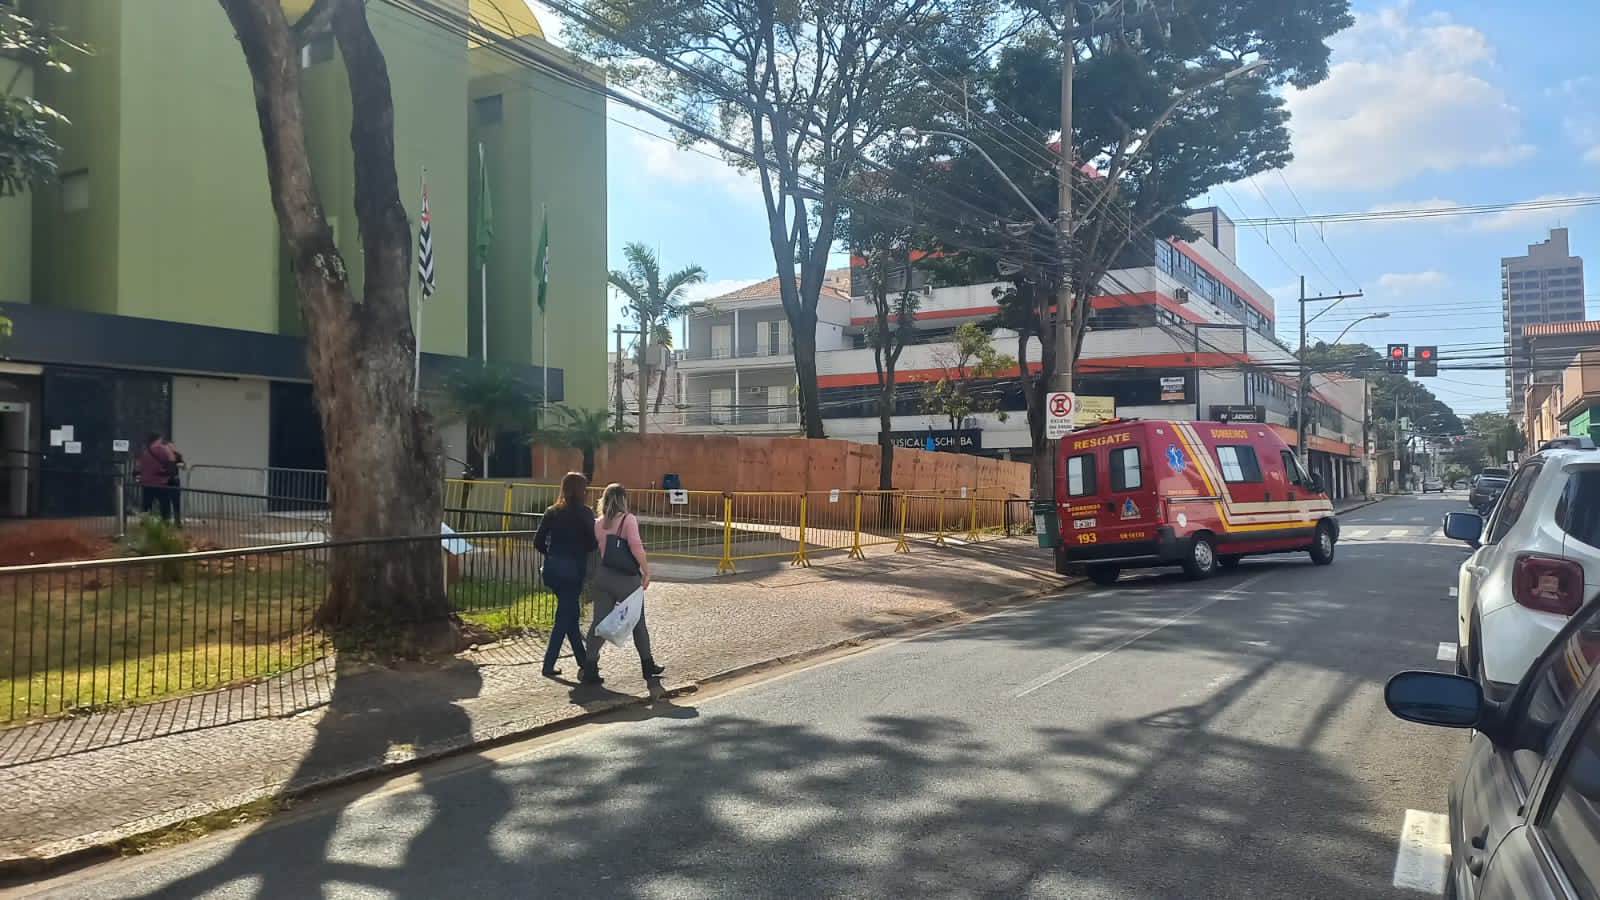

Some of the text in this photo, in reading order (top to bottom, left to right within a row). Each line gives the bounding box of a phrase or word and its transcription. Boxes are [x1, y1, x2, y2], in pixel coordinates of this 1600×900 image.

[891, 437, 926, 448] USICAL
[1074, 432, 1131, 450] RESGATE
[1077, 532, 1097, 544] 193
